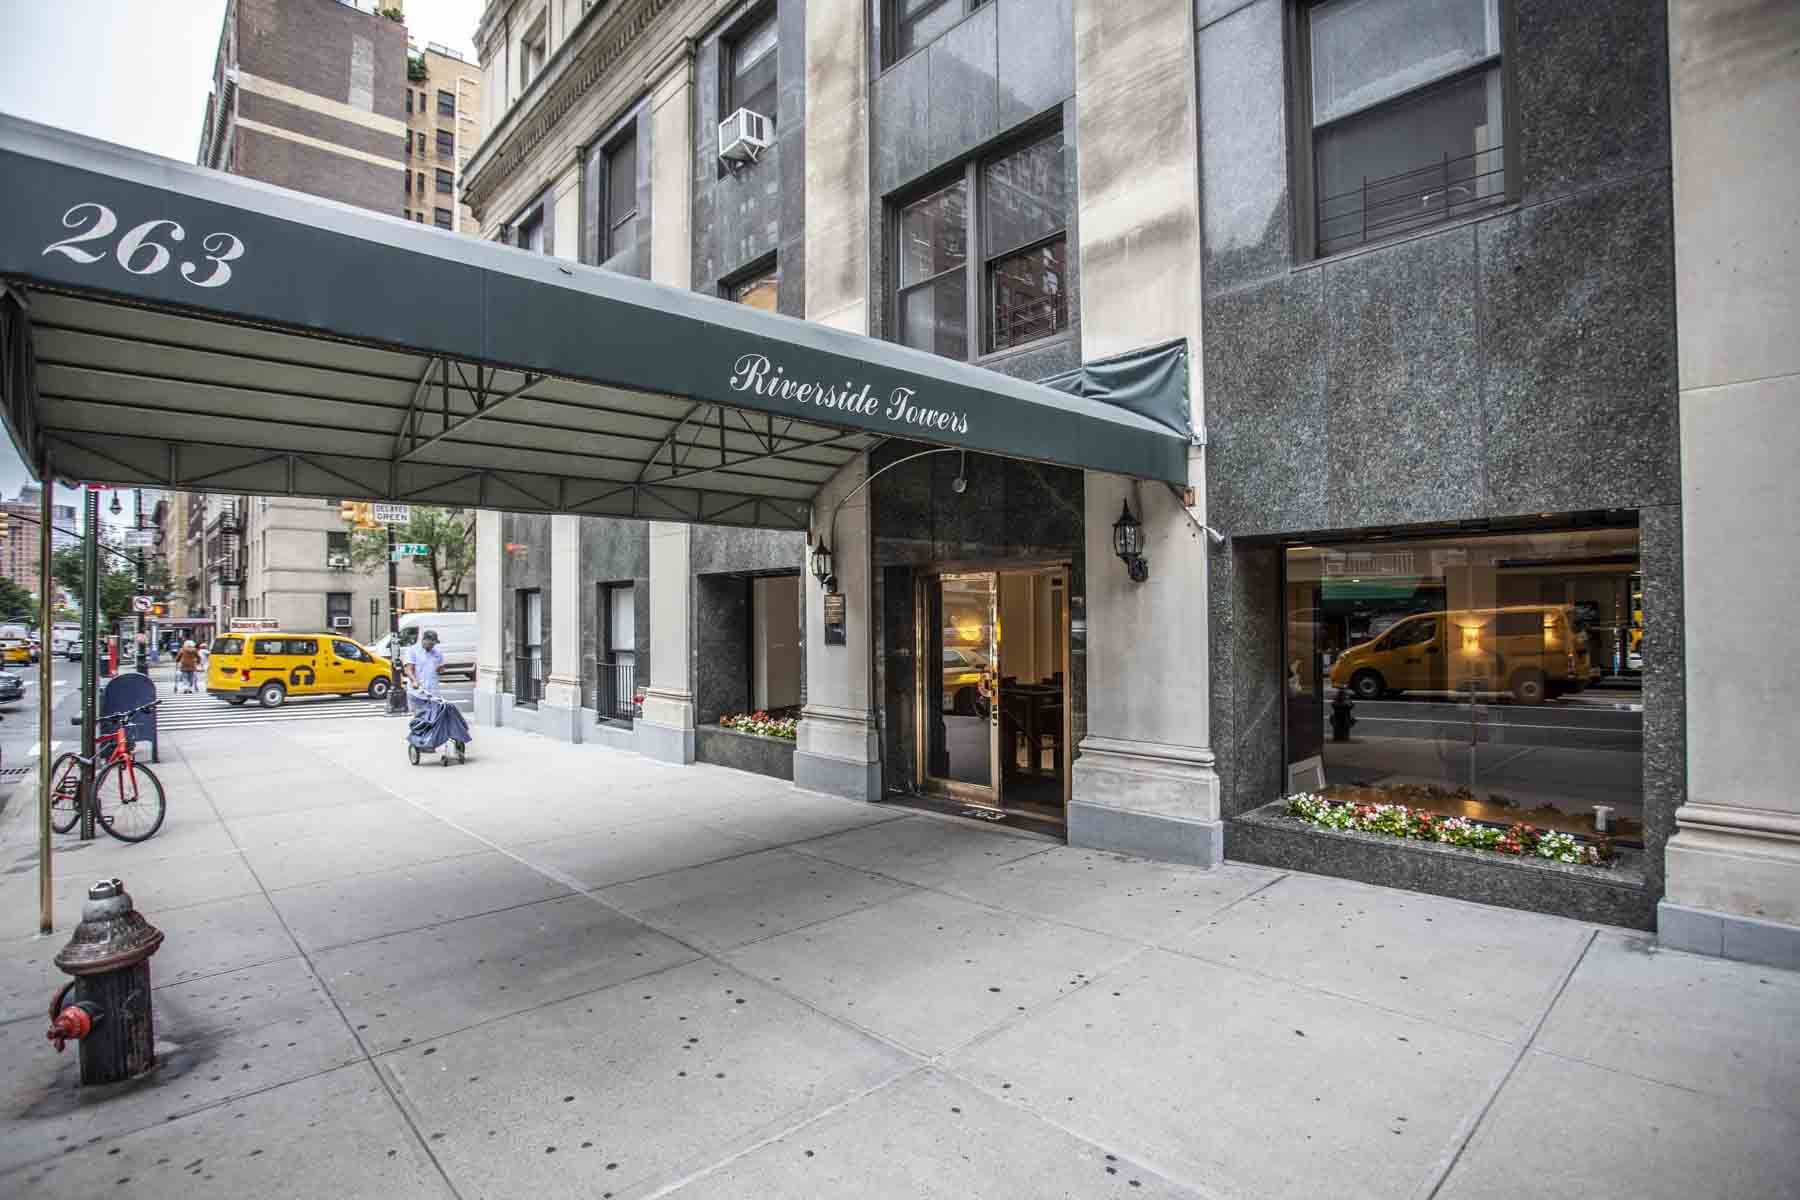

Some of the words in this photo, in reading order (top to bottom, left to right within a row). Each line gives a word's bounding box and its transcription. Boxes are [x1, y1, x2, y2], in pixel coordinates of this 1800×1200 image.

[42, 203, 245, 287] 263
[730, 353, 879, 416] Riverside
[886, 386, 969, 434] Towers
[375, 504, 408, 513] DELAYED
[377, 512, 408, 521] GREEN
